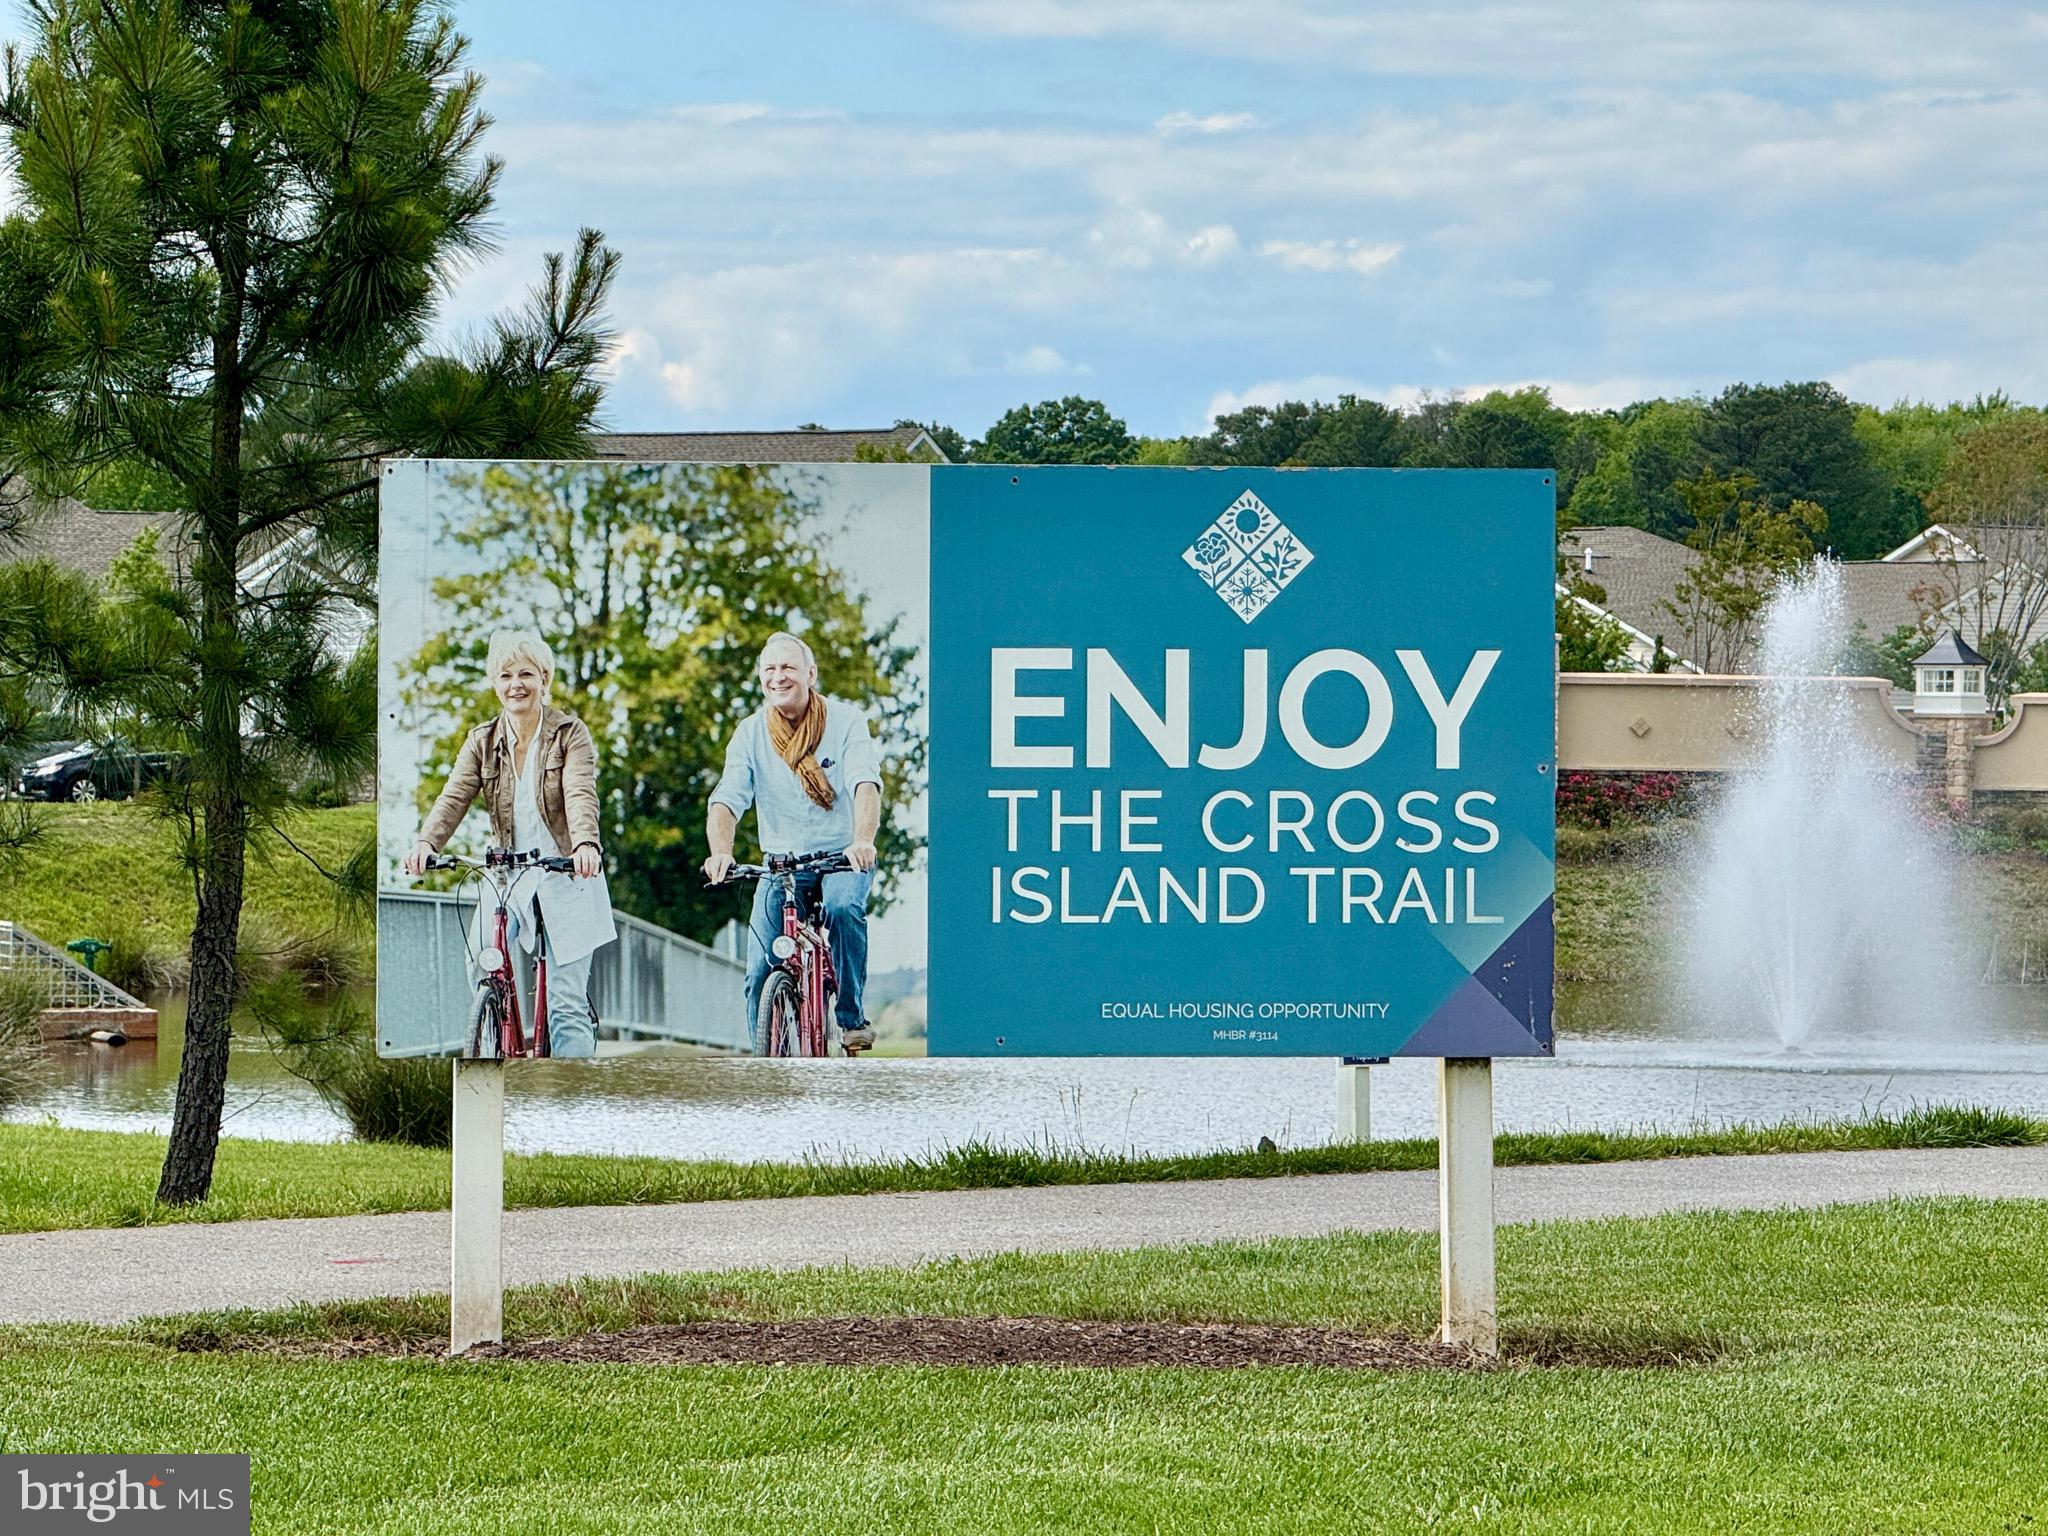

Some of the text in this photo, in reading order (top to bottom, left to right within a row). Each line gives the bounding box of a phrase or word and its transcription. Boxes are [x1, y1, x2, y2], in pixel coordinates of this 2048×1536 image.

[990, 647, 1502, 771] ENJOY
[988, 789, 1500, 854] THE CROSS
[992, 866, 1505, 924] ISLAND TRAIL
[1101, 1002, 1390, 1020] EQUAL HOUSING OPPORTUNITY
[1213, 1030, 1279, 1042] MHBR #3114
